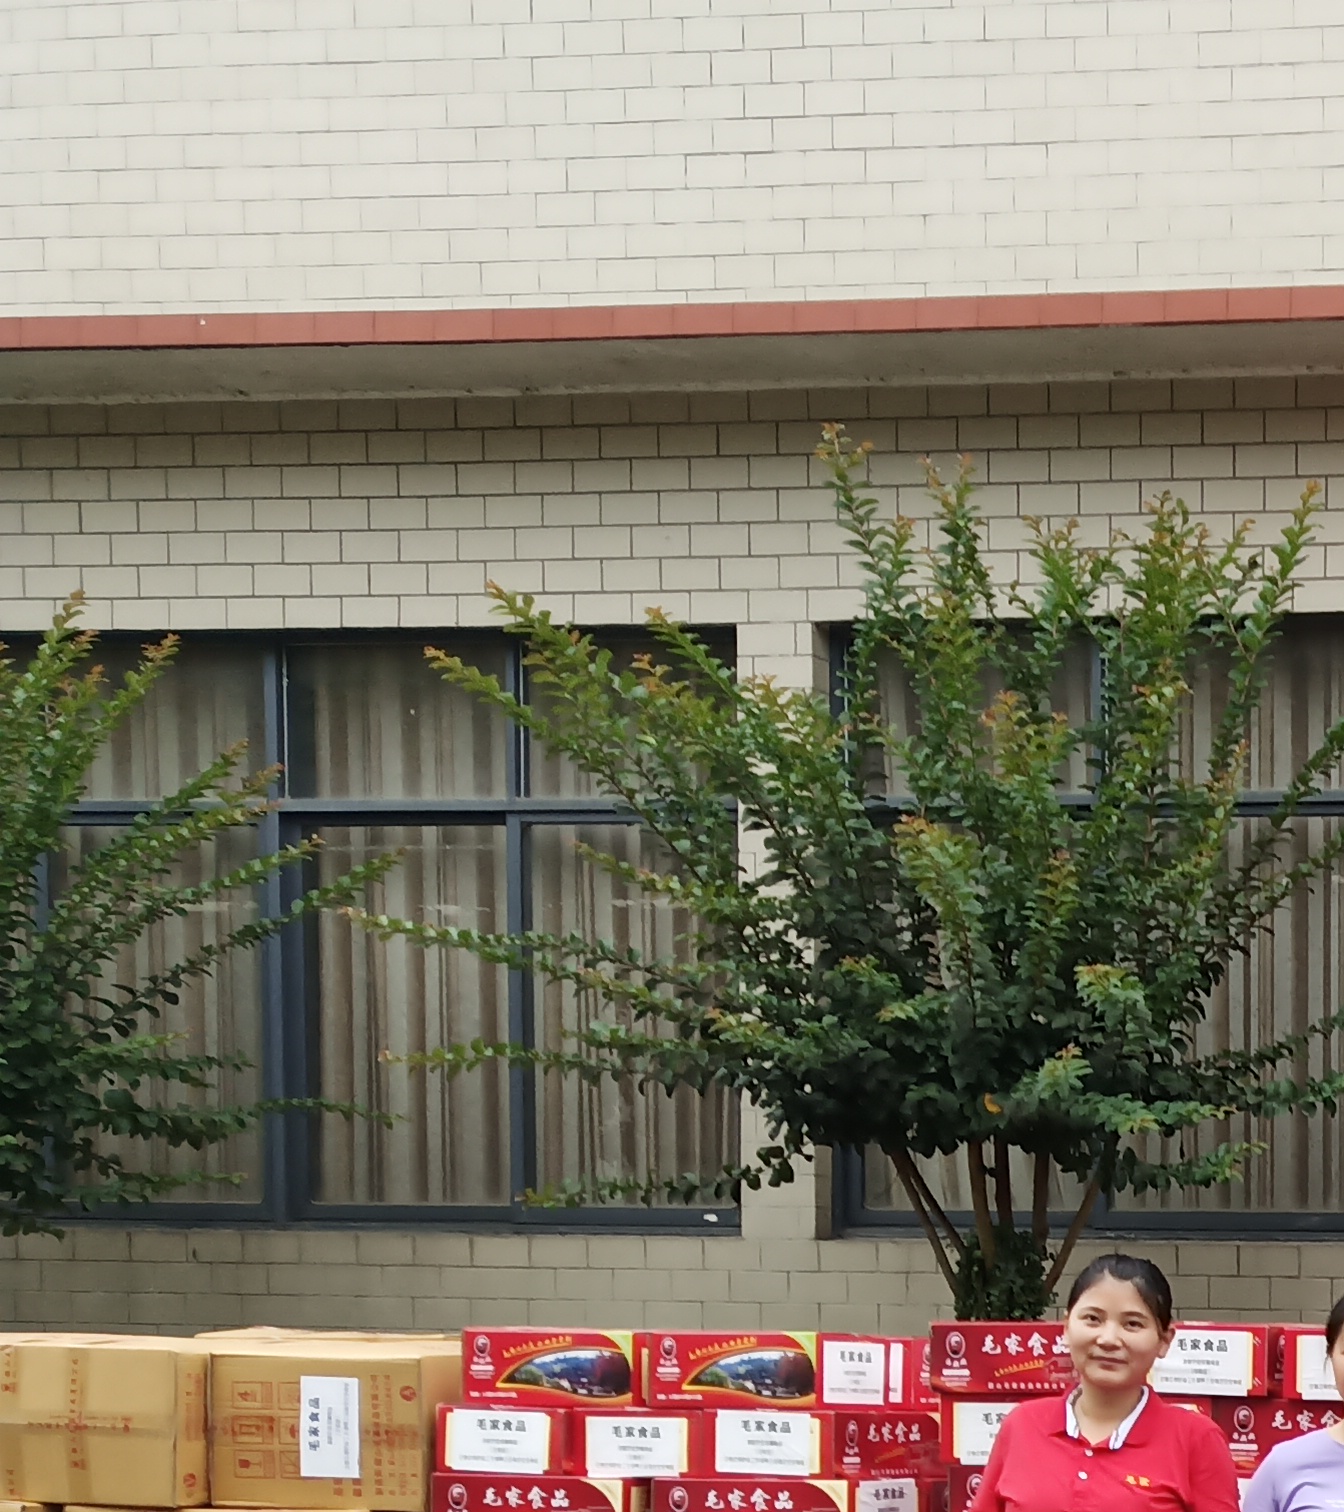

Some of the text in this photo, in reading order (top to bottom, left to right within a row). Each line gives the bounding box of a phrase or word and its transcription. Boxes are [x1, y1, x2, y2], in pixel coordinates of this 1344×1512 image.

[1178, 1339, 1228, 1353] 毛家食品
[477, 1419, 526, 1432] 毛家食品
[741, 1420, 791, 1434] 毛家食品
[612, 1426, 661, 1440] 毛家食品
[483, 1486, 570, 1509] 毛家食品
[705, 1488, 794, 1511] 毛家食品
